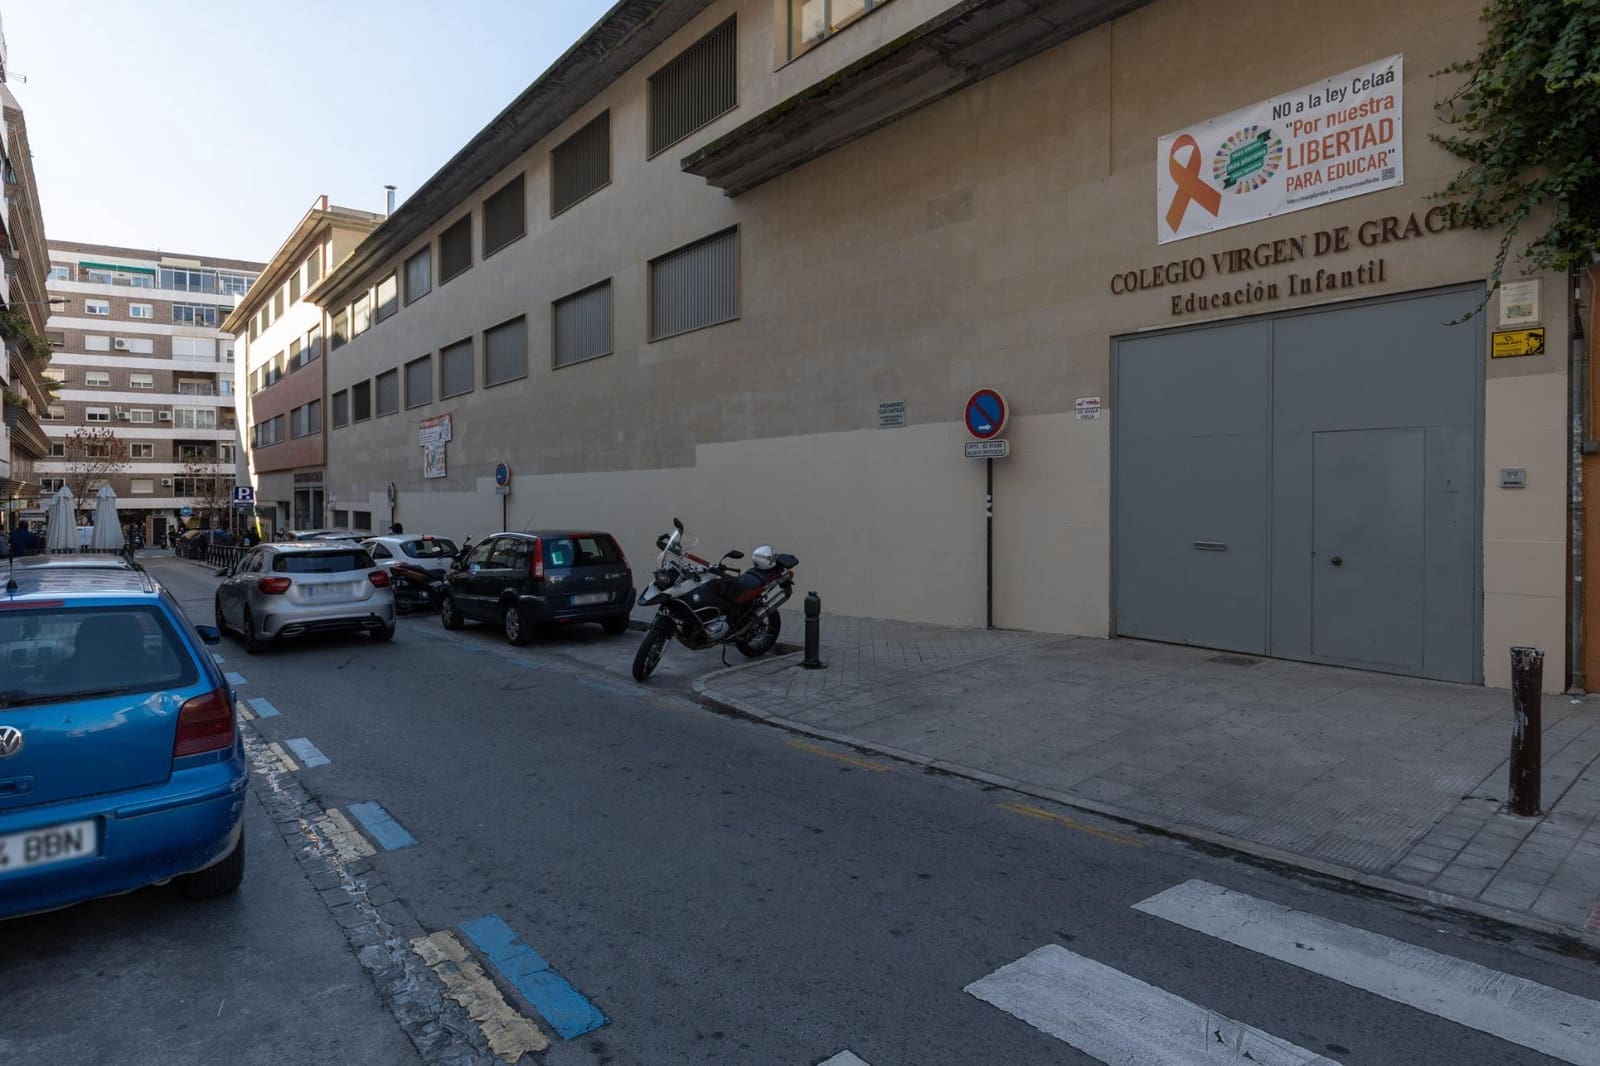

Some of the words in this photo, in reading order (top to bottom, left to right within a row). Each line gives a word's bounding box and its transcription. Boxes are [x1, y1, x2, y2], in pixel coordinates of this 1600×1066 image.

[1272, 102, 1291, 121] NO
[1296, 102, 1304, 113] a
[1309, 94, 1321, 108] la
[1326, 86, 1347, 104] ley
[1352, 66, 1394, 94] Celaá
[1327, 95, 1395, 126] nuestra
[1286, 117, 1395, 170] LIBERTAD
[1286, 172, 1323, 193] PARA
[1110, 257, 1206, 295] COLEGIO
[1212, 235, 1306, 275] VIRGEN
[1314, 226, 1350, 257] DE
[1289, 259, 1387, 298] Infantil
